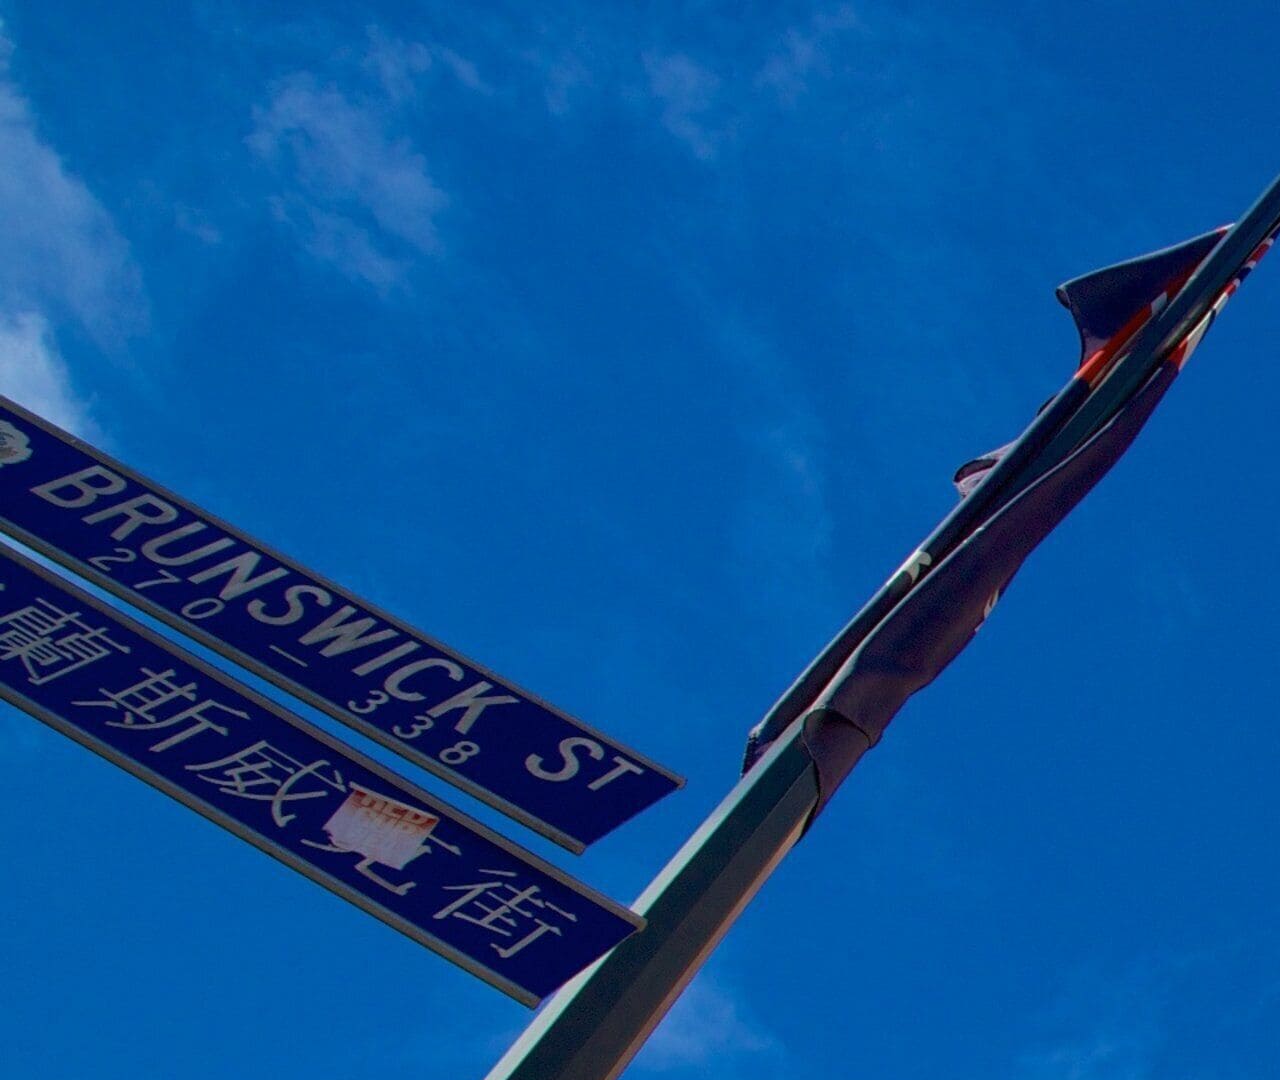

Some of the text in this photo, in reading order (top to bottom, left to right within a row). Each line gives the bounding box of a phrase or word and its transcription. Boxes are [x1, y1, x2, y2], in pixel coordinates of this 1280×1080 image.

[29, 464, 644, 792] BRUNSWICK ST
[88, 547, 225, 621] 270
[346, 689, 480, 766] 338
